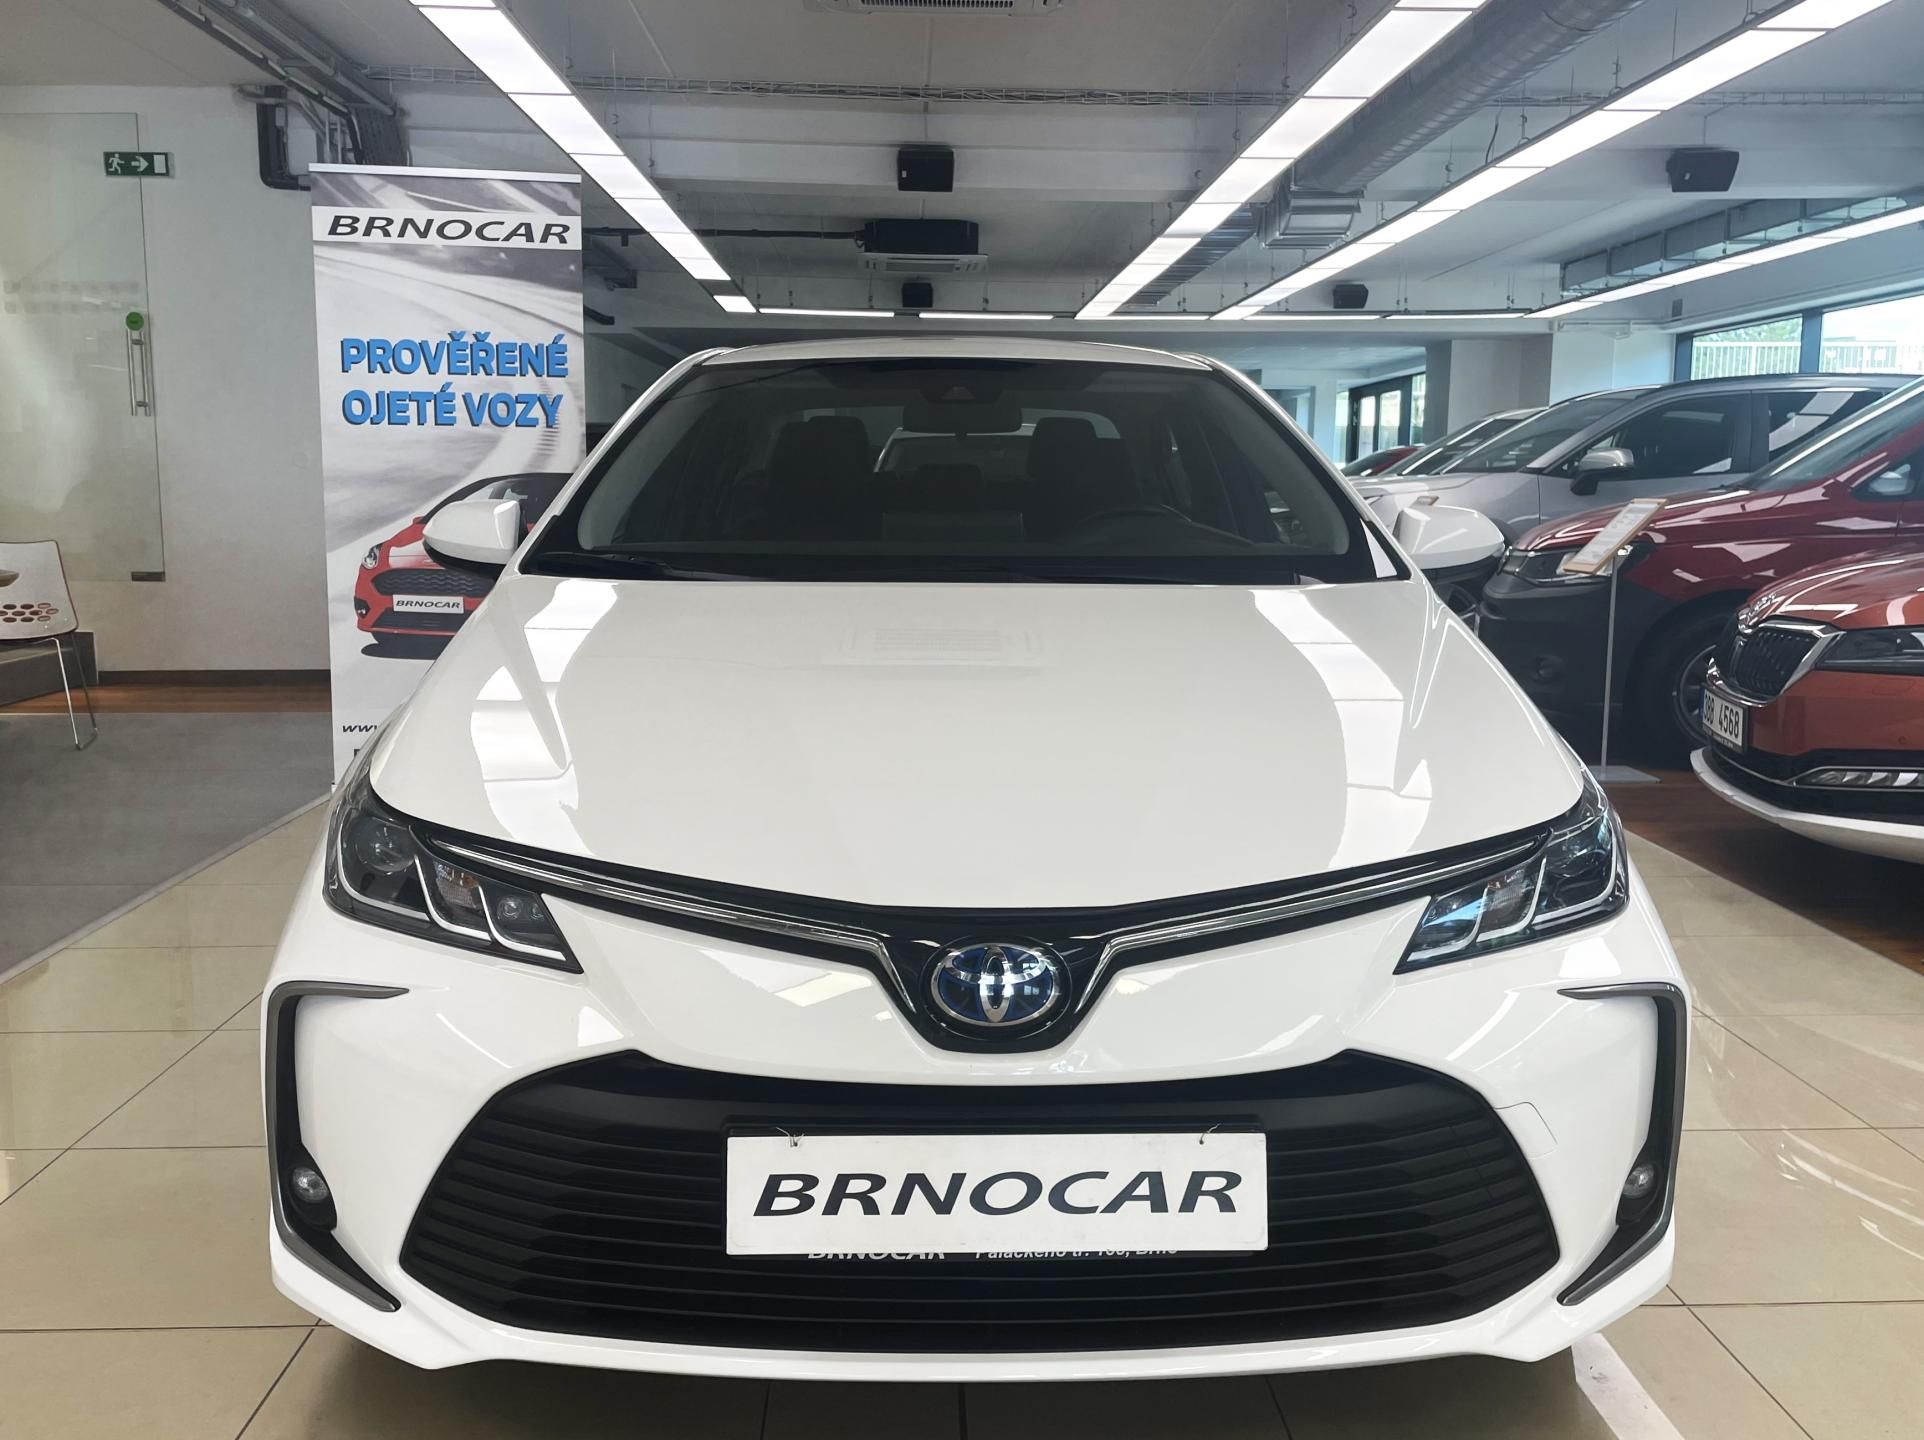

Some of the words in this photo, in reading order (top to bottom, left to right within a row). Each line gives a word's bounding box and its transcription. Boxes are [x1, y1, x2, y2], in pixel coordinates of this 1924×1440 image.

[328, 215, 570, 244] BRNOCAR
[341, 331, 568, 377] PROVĚŘENÉ
[342, 382, 456, 425] OJETÉ
[462, 392, 563, 428] VOZY
[396, 600, 460, 609] BRNOCAR
[1719, 704, 1739, 739] 4568
[753, 1171, 1242, 1216] BRNOCAR
